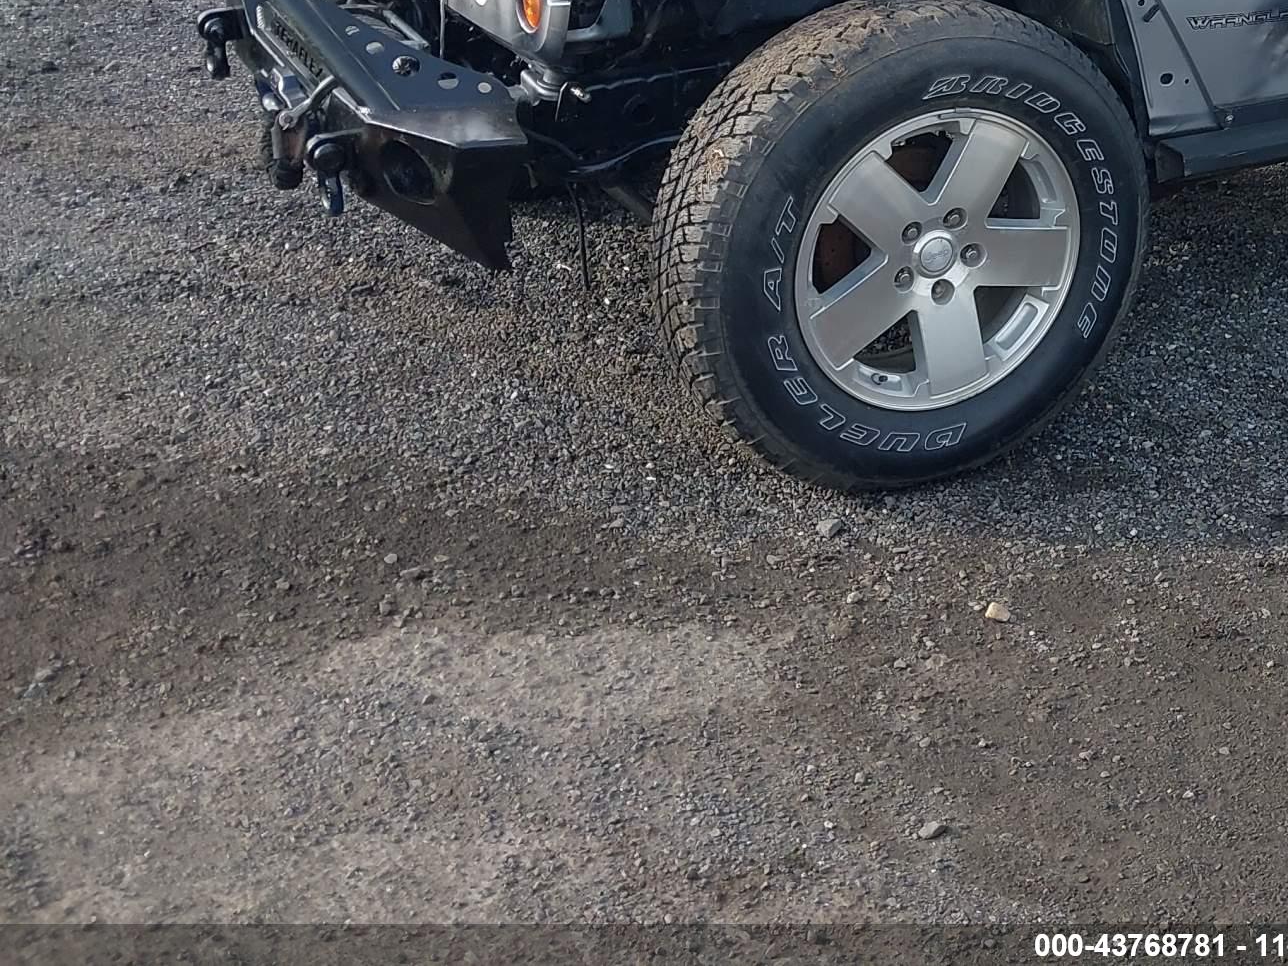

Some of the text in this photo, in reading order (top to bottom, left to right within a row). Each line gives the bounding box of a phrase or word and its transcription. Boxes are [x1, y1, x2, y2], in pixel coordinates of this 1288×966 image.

[763, 195, 967, 453] DUELER A/T
[922, 74, 1119, 339] BRIDGESTONE
